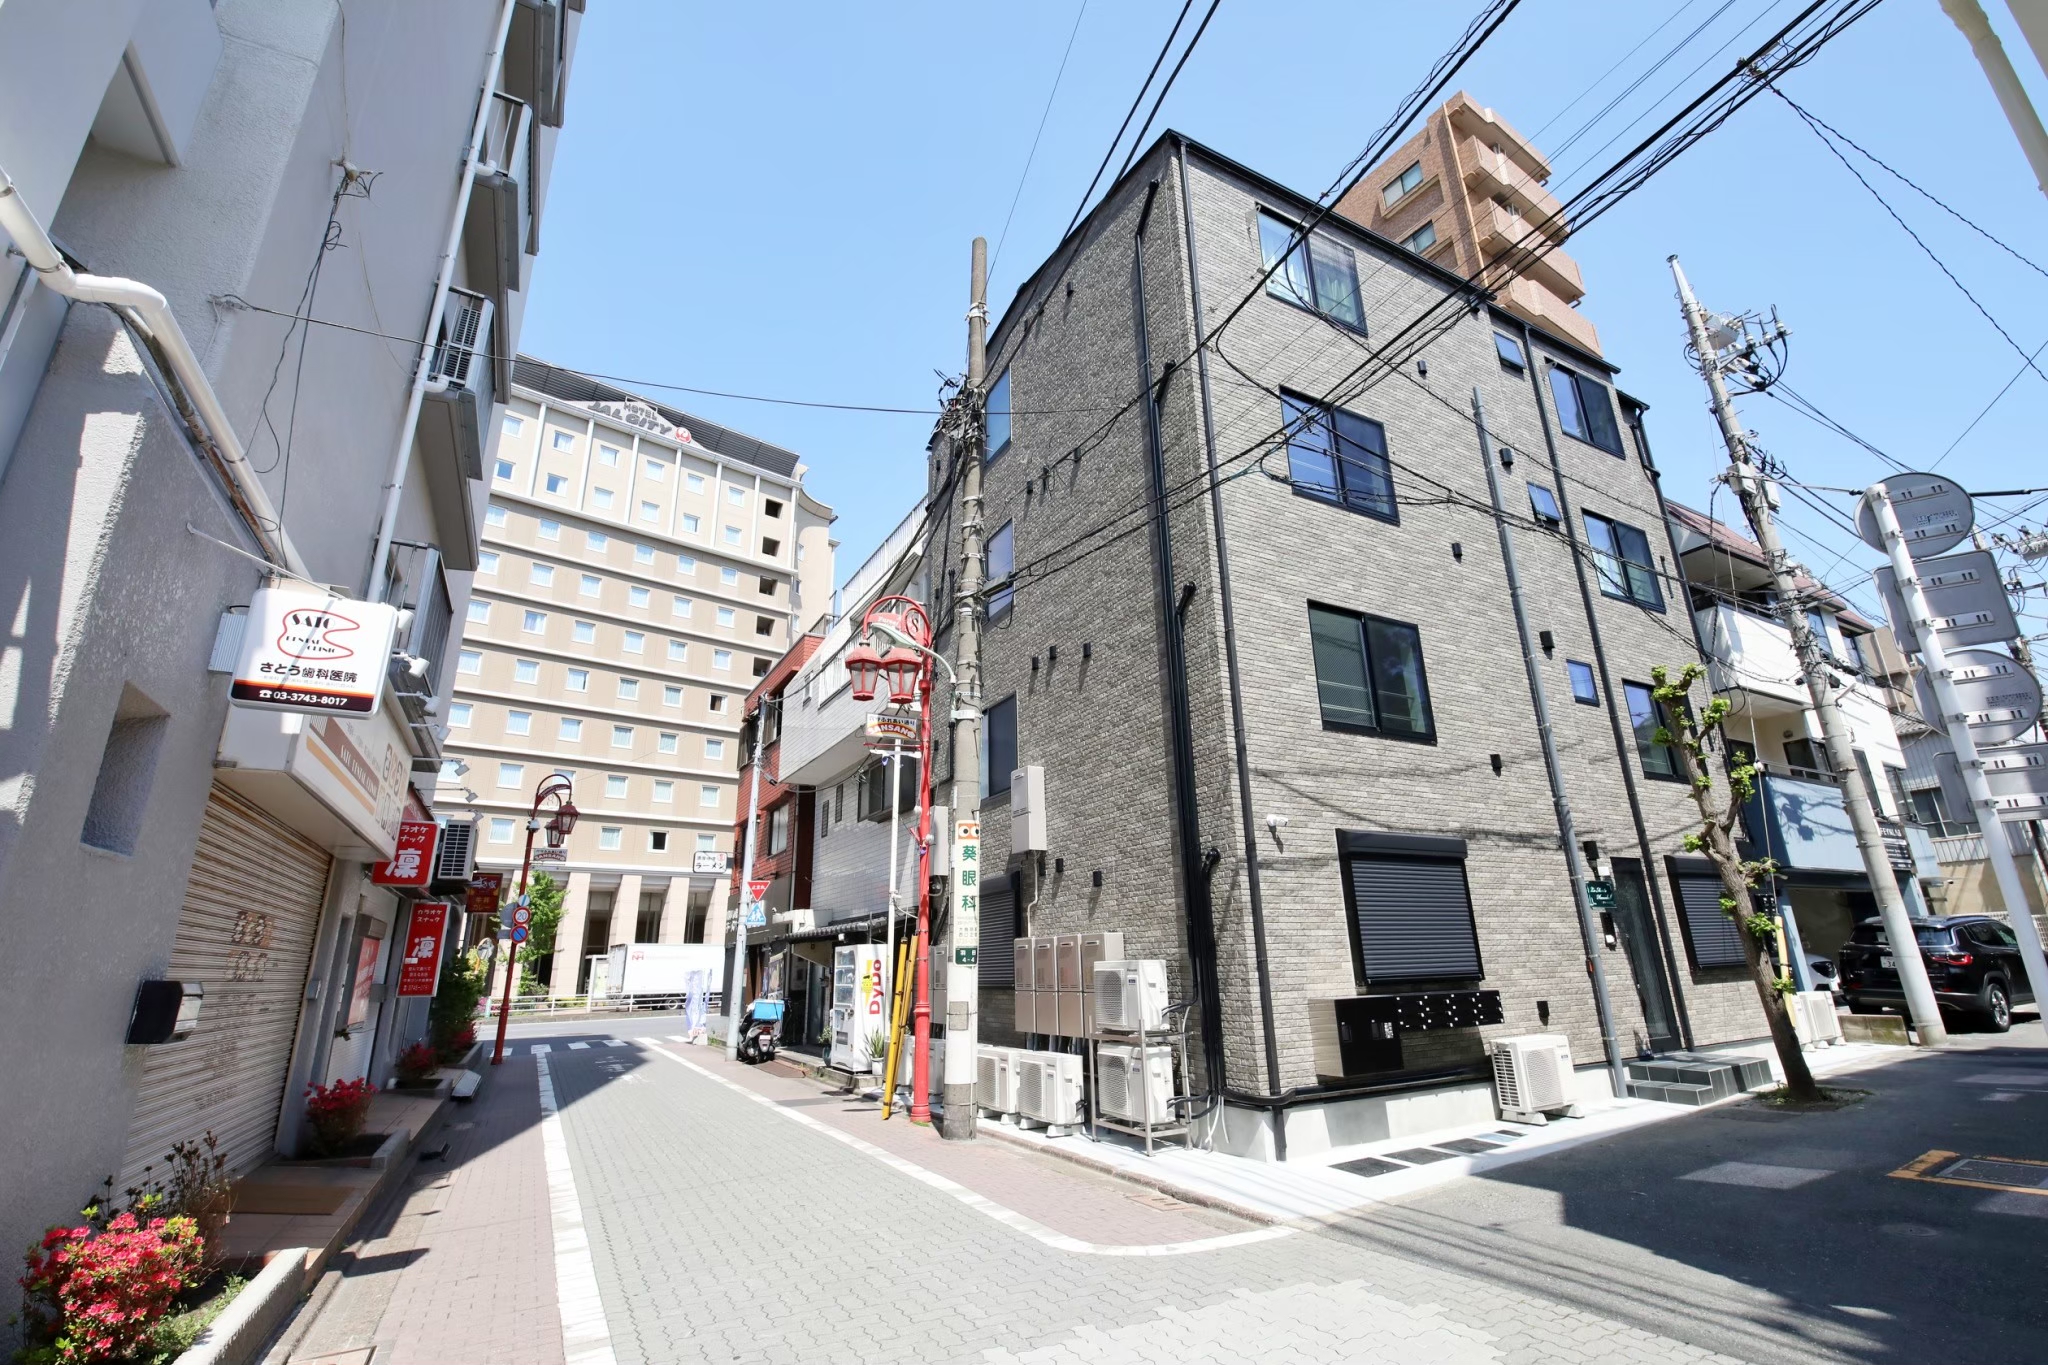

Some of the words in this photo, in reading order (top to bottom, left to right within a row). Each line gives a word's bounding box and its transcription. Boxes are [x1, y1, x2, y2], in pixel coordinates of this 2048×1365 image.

[587, 401, 623, 421] JAL
[625, 413, 672, 435] CITY
[624, 402, 657, 421] HOTEL
[291, 613, 335, 630] SATO
[260, 662, 358, 682] さとう歯科医院
[273, 690, 348, 706] 03-3743-8017
[961, 844, 977, 912] 葵眼科
[516, 911, 527, 921] 20
[869, 959, 885, 1015] DyDo
